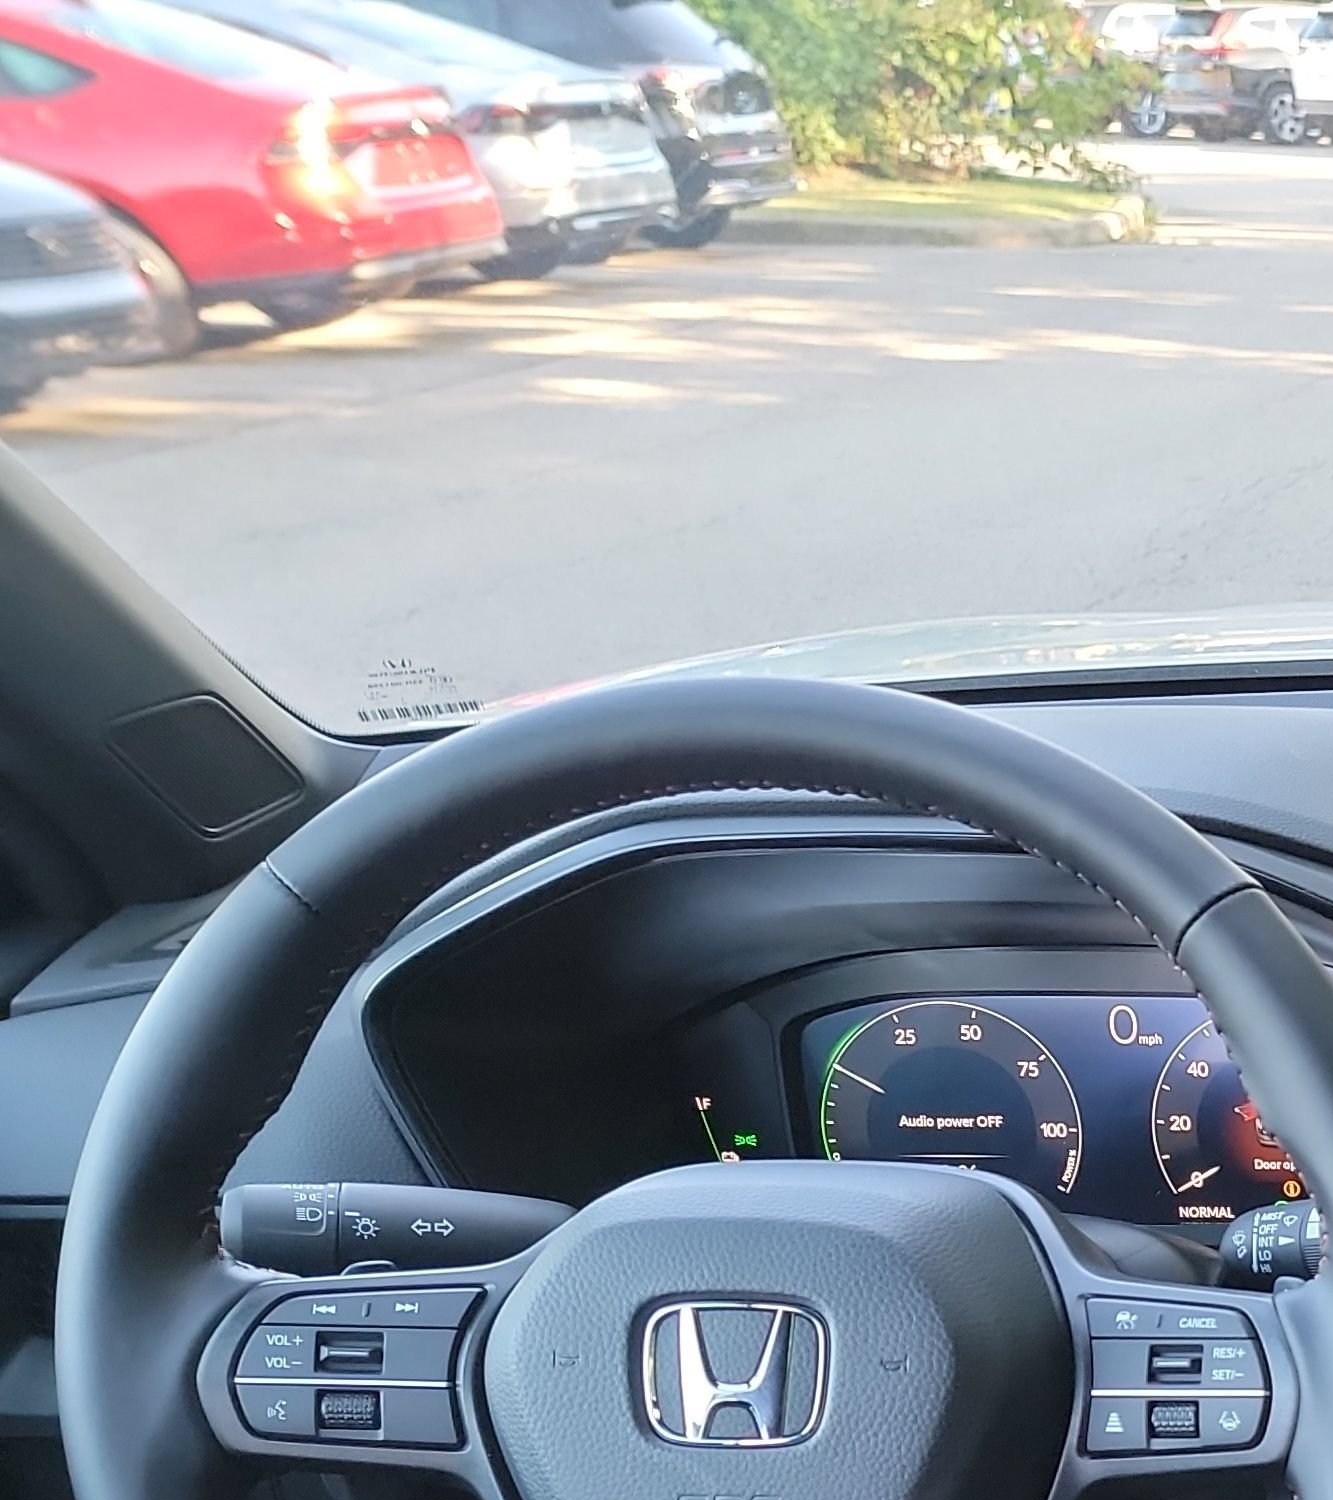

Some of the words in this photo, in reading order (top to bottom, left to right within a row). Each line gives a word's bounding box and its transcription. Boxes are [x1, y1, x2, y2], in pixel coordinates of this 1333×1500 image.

[960, 1025, 982, 1041] 50
[1108, 1004, 1138, 1045] 0
[1138, 1034, 1162, 1046] mph
[895, 1029, 916, 1045] 25
[1017, 1061, 1039, 1077] 75
[1187, 1062, 1209, 1078] 40
[899, 1115, 935, 1128] Audio
[937, 1117, 974, 1130] power
[976, 1115, 1003, 1128] OFF
[1169, 1115, 1191, 1132] 20
[1040, 1123, 1067, 1139] 100
[1061, 1156, 1076, 1183] POWER
[1254, 1159, 1281, 1171] Door
[1179, 1206, 1235, 1218] NORMAL
[1259, 1224, 1278, 1234] OFF
[1259, 1236, 1274, 1247] INT
[1259, 1250, 1272, 1261] LO
[1179, 1318, 1217, 1328] CANCEL
